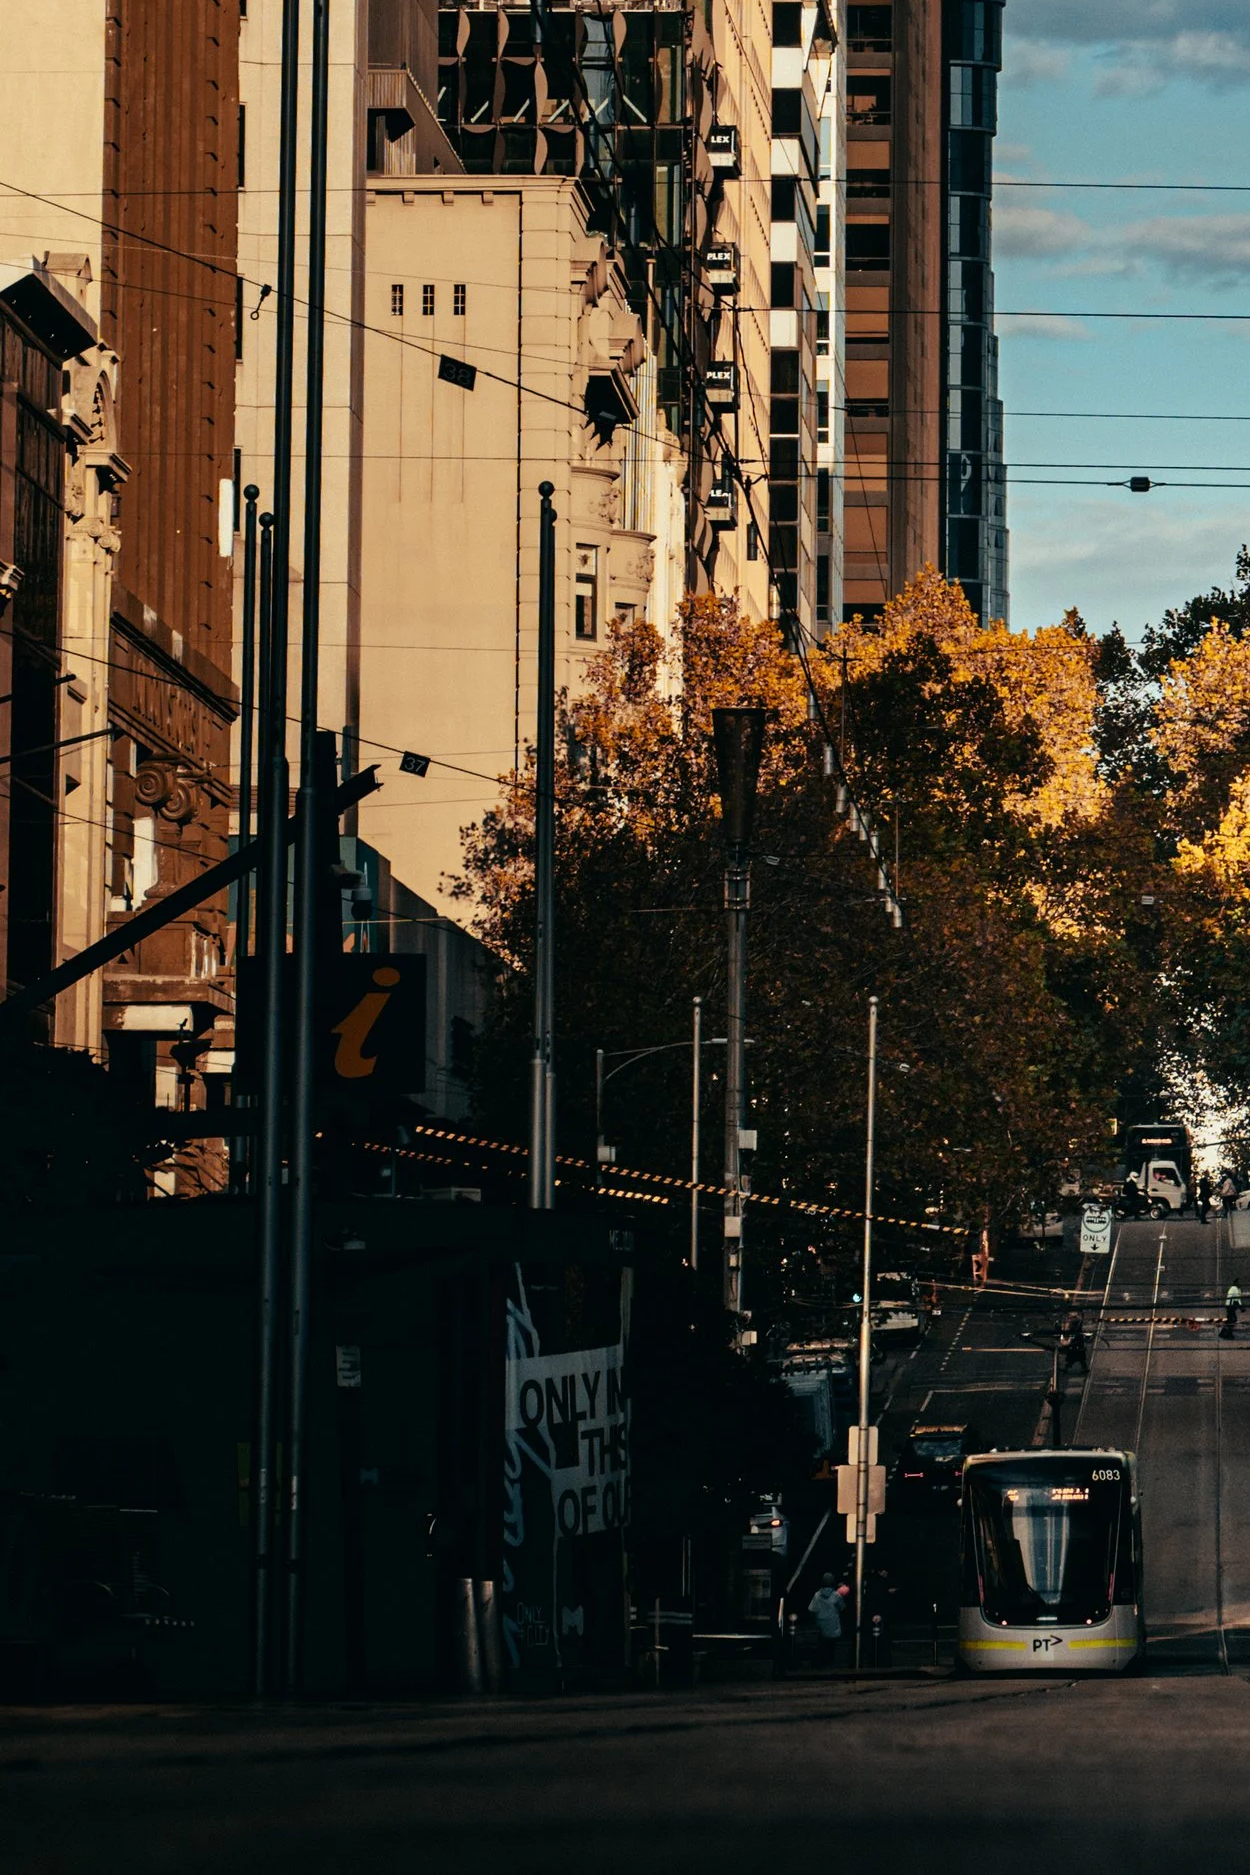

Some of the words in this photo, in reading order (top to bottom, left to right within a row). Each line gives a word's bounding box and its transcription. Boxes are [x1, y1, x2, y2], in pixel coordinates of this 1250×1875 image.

[443, 362, 471, 385] 38
[706, 371, 731, 379] PLEX
[404, 756, 426, 773] 37
[1083, 1234, 1108, 1242] ONLY
[520, 1370, 601, 1427] ONLY
[580, 1421, 629, 1476] THIS
[1091, 1469, 1121, 1481] 6083
[558, 1484, 597, 1539] OF
